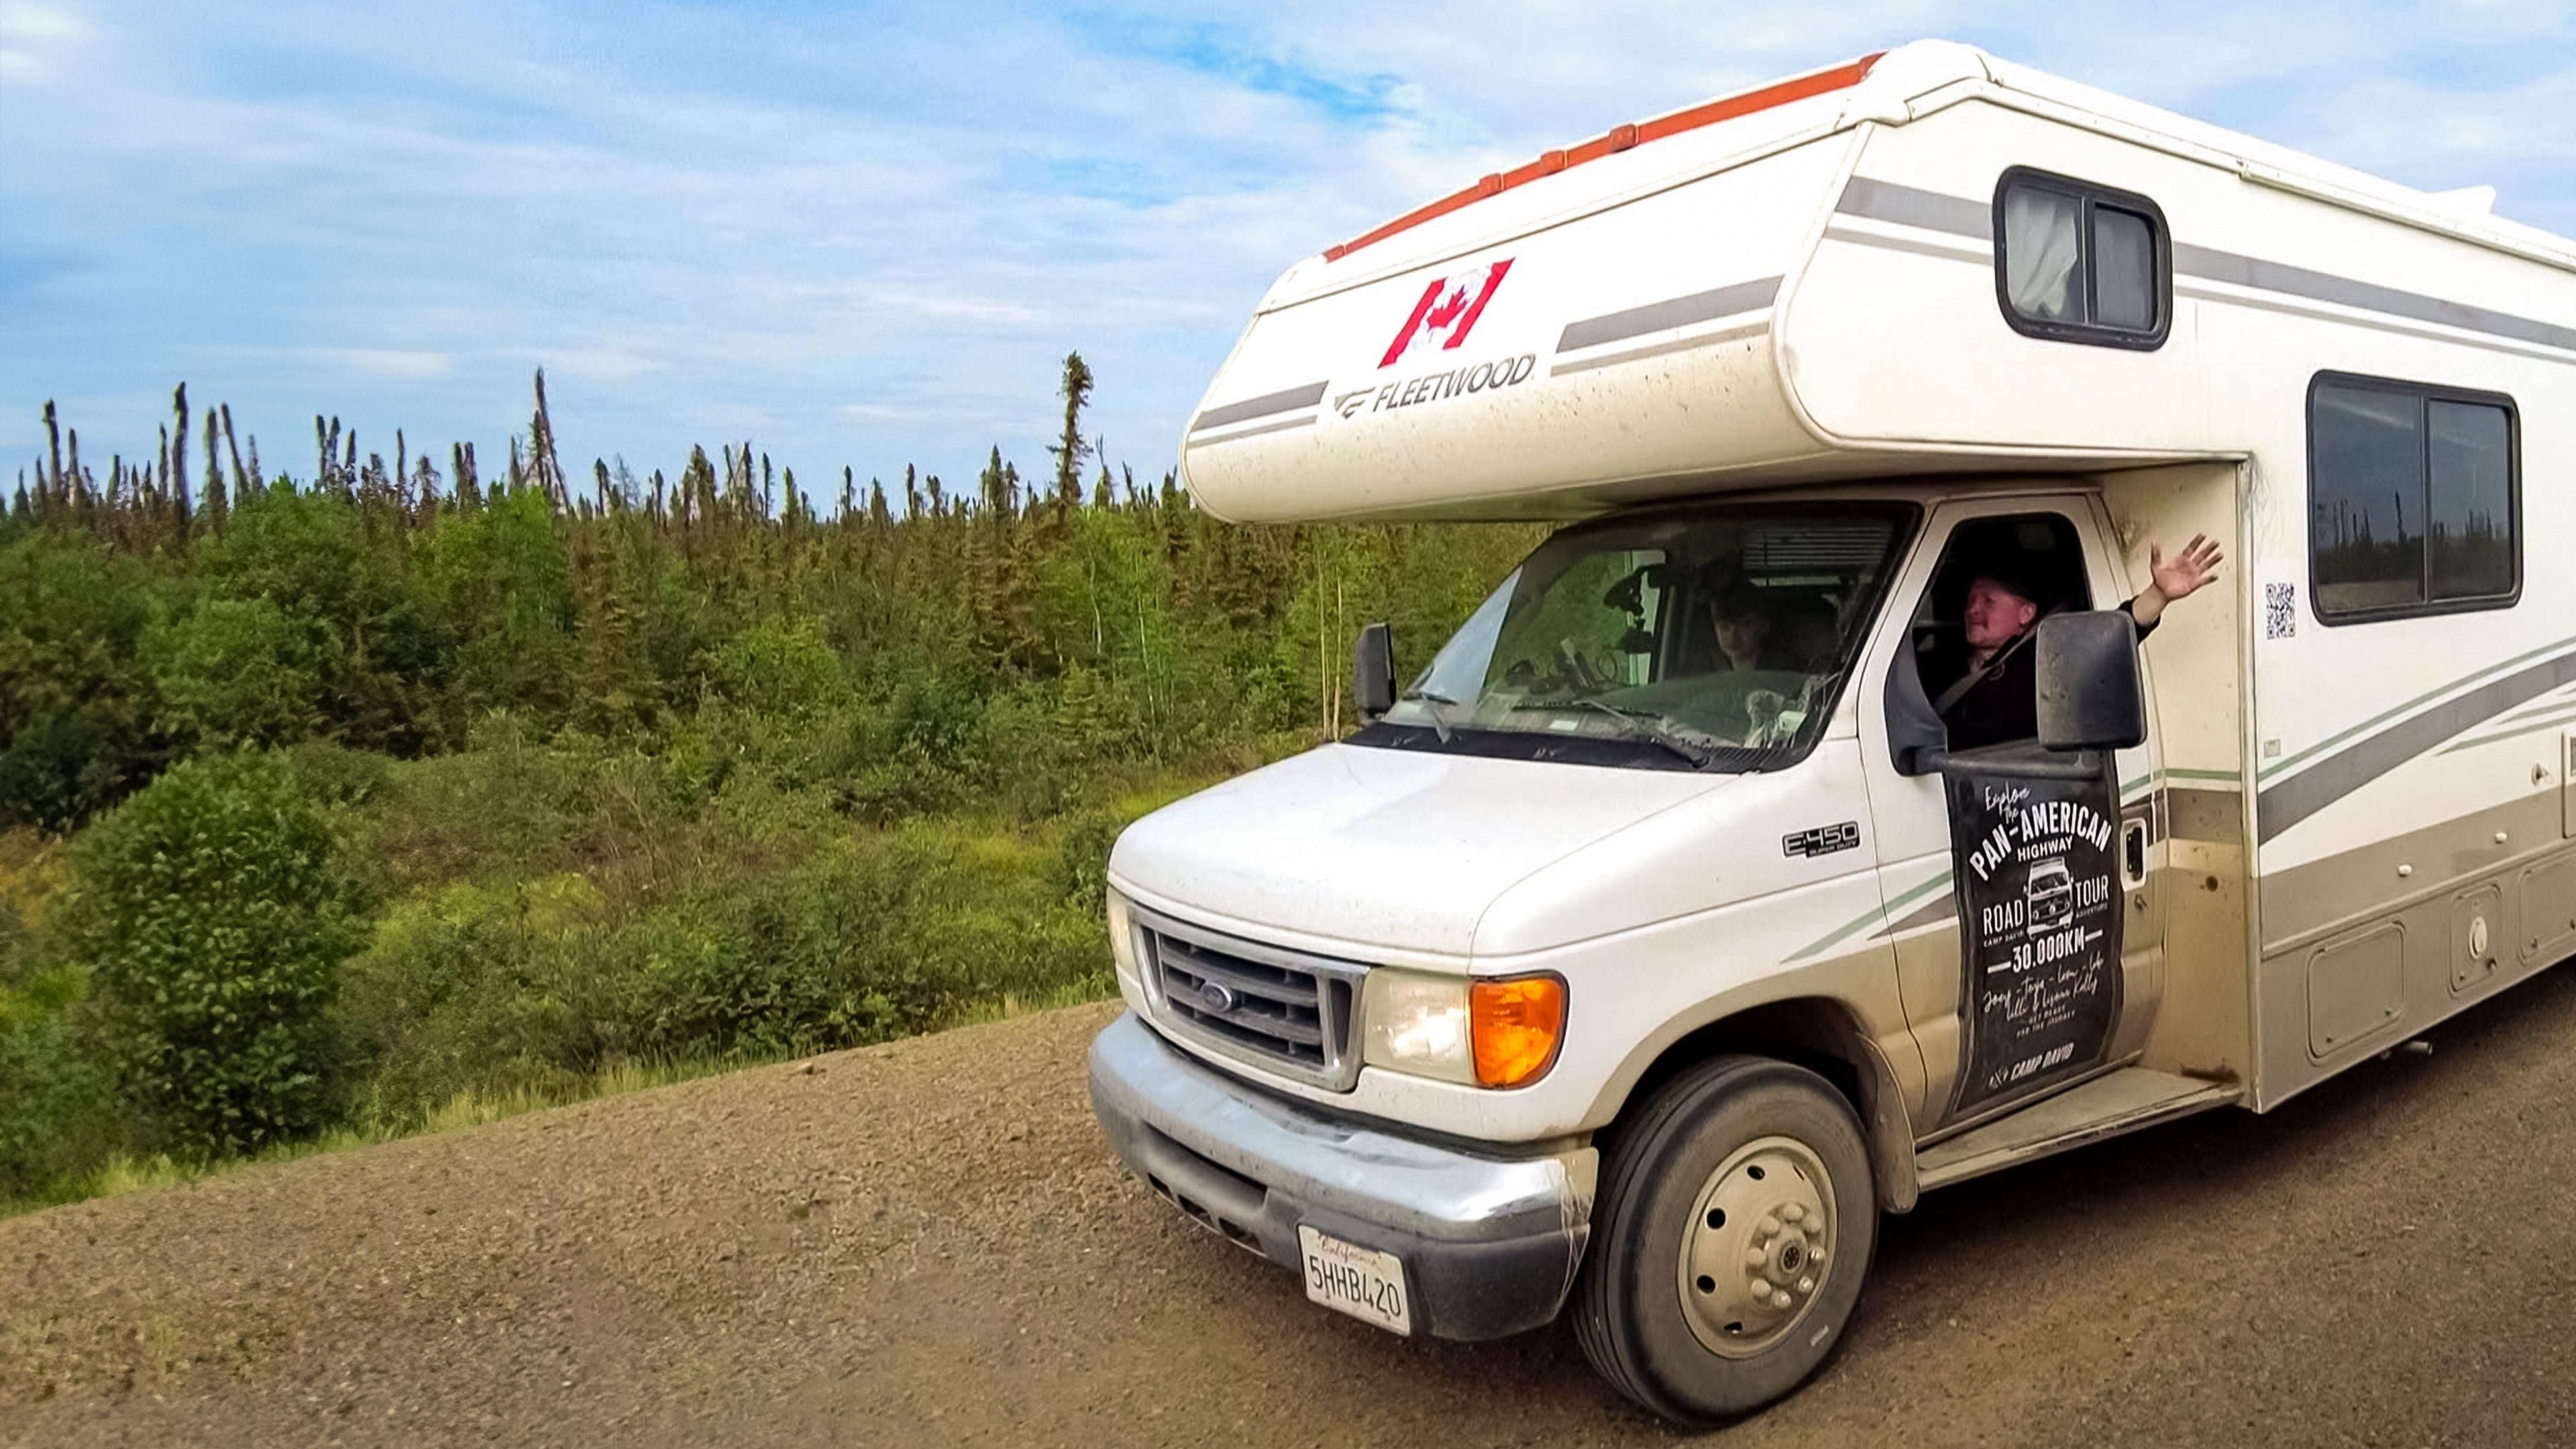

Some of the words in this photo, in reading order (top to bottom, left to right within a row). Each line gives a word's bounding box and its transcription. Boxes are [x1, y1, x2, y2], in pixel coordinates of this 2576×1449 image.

[1373, 354, 1536, 413] FLEETWOOD
[1970, 802, 2112, 881] PAN-AMERICAN
[2017, 836, 2074, 862] HIGHWAY
[1983, 900, 2024, 936] ROAD
[2076, 875, 2109, 908] TOUR
[2011, 1054, 2042, 1081] CAMP
[2042, 1042, 2074, 1068] DAVID
[1321, 1236, 1377, 1265] California
[1309, 1254, 1401, 1317] 5HHB420
